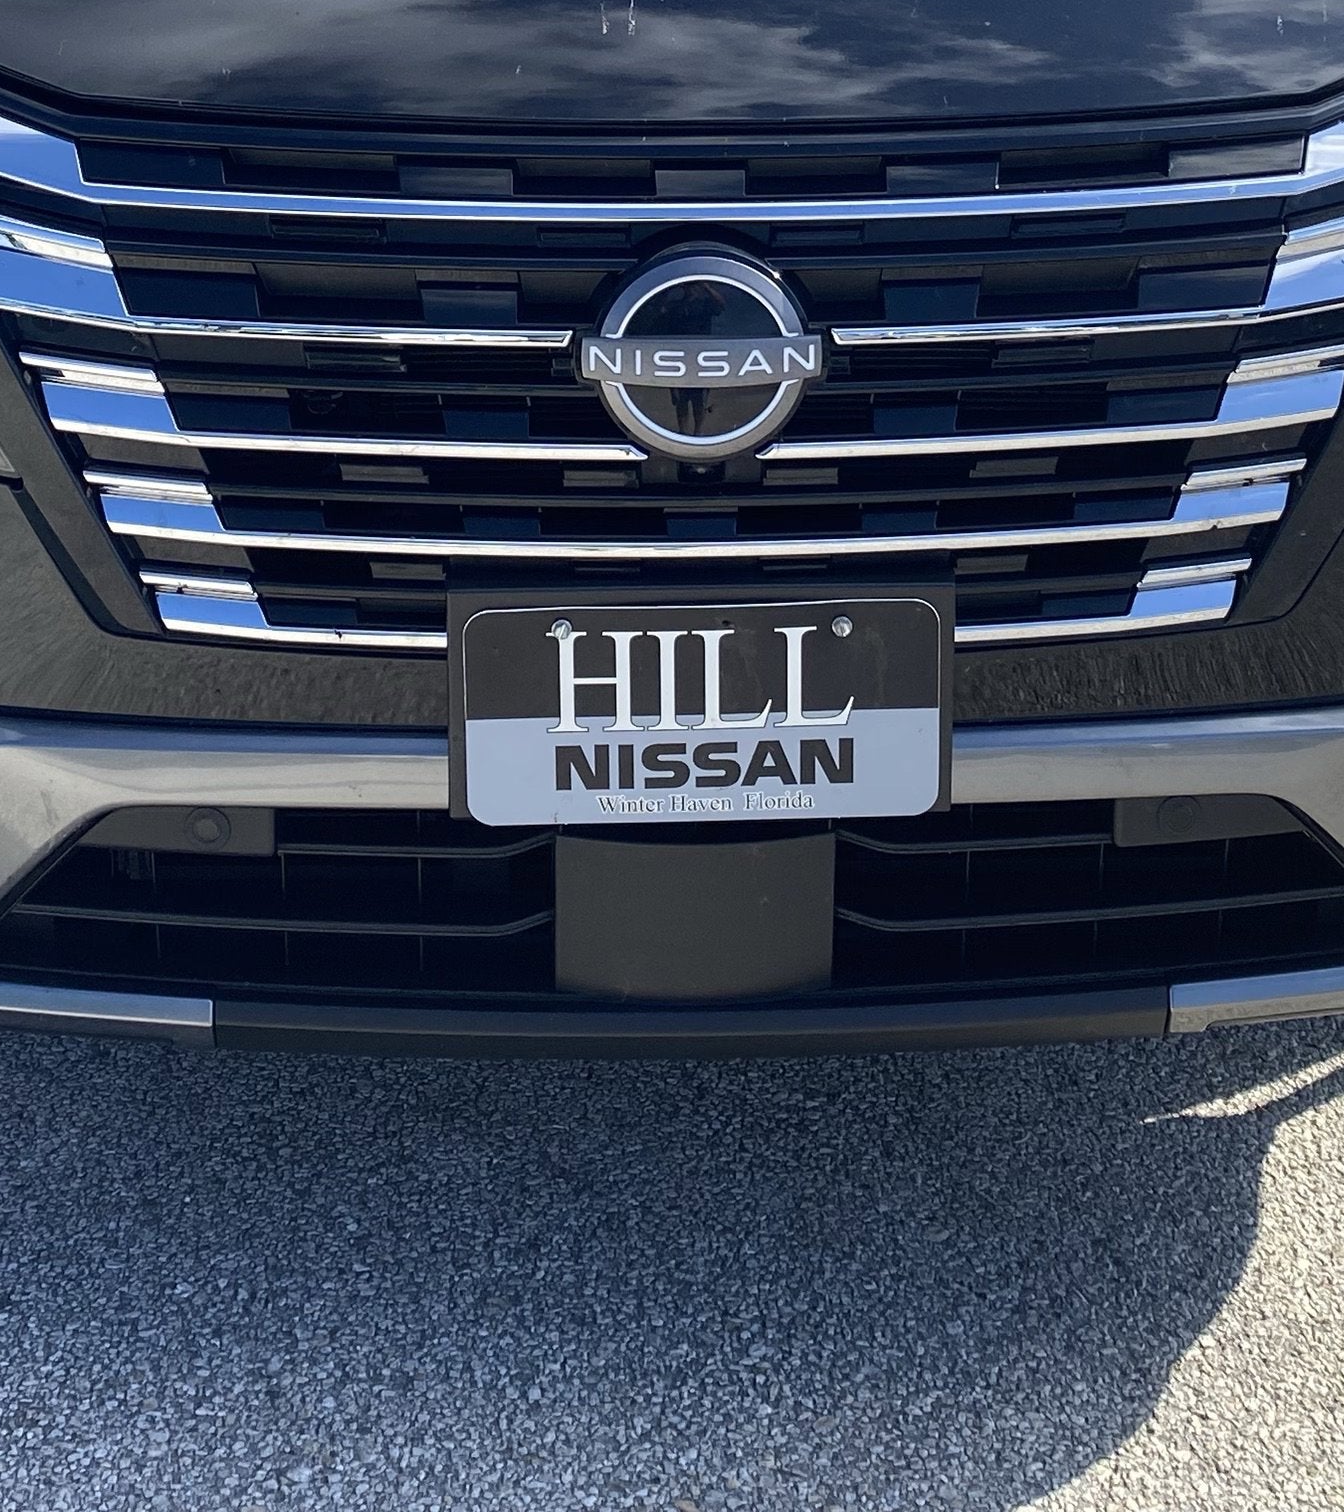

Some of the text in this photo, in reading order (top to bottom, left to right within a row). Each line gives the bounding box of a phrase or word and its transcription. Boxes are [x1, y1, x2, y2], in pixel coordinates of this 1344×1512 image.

[588, 343, 816, 377] NISSAN
[545, 624, 855, 733] HILL
[555, 737, 855, 791] NISSAN
[598, 792, 815, 814] Winter Haven Florida
